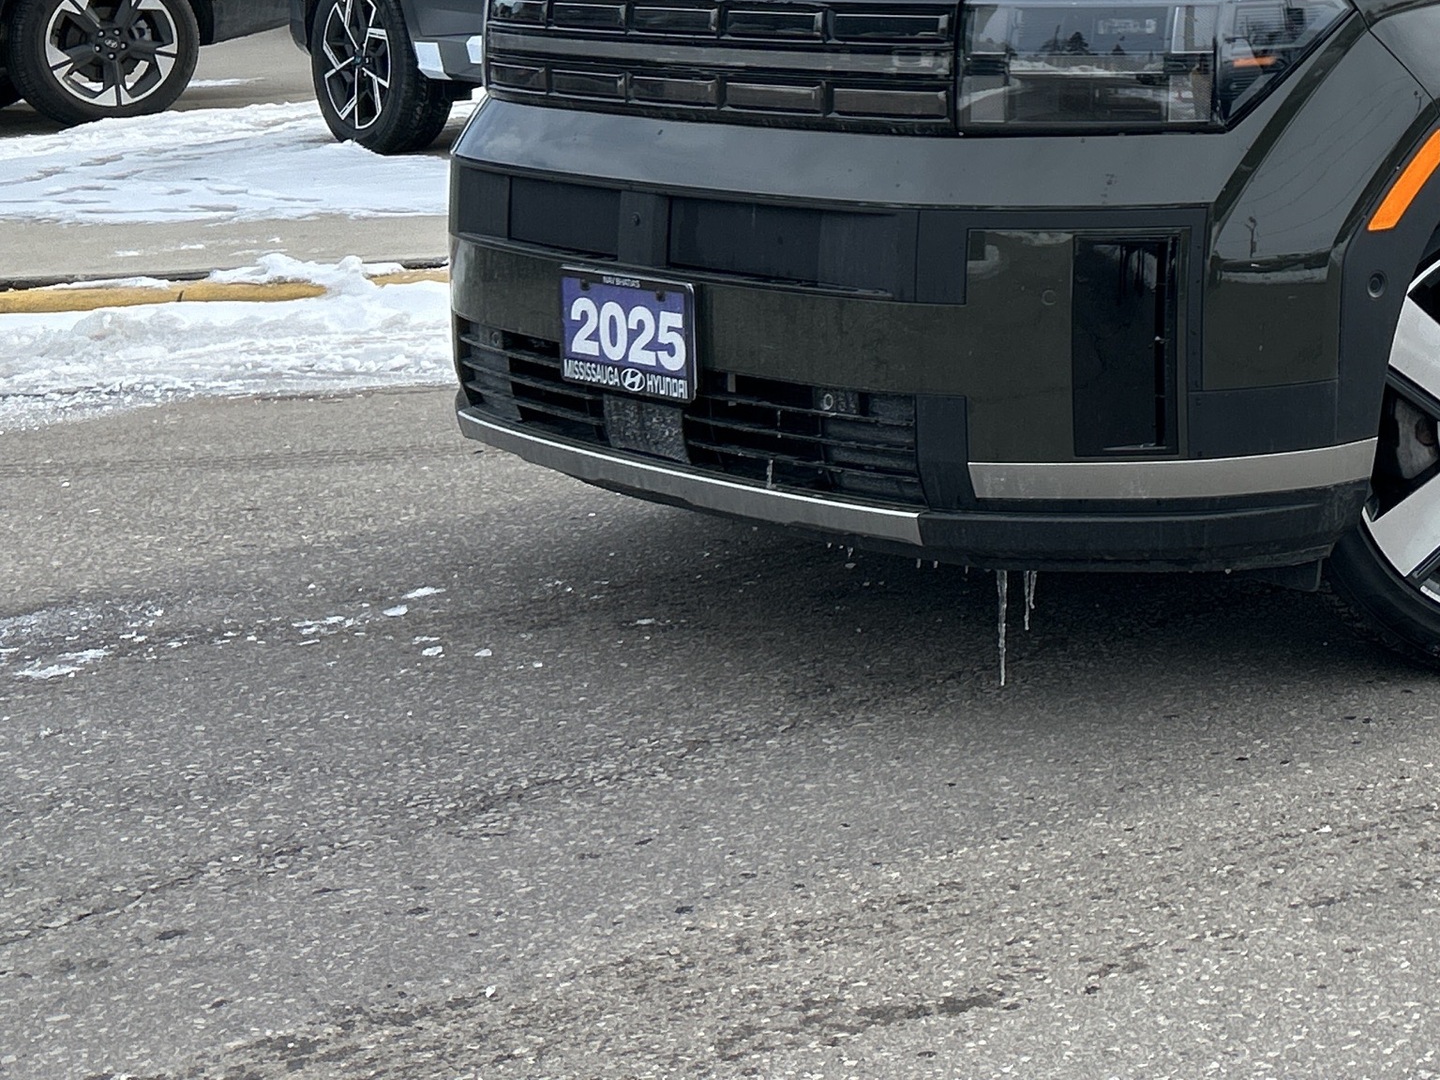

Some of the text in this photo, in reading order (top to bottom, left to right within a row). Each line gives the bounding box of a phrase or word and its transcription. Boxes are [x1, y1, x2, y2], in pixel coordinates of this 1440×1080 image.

[571, 297, 686, 371] 2025
[564, 359, 688, 399] MISSISSAUGA HYUNDAI
